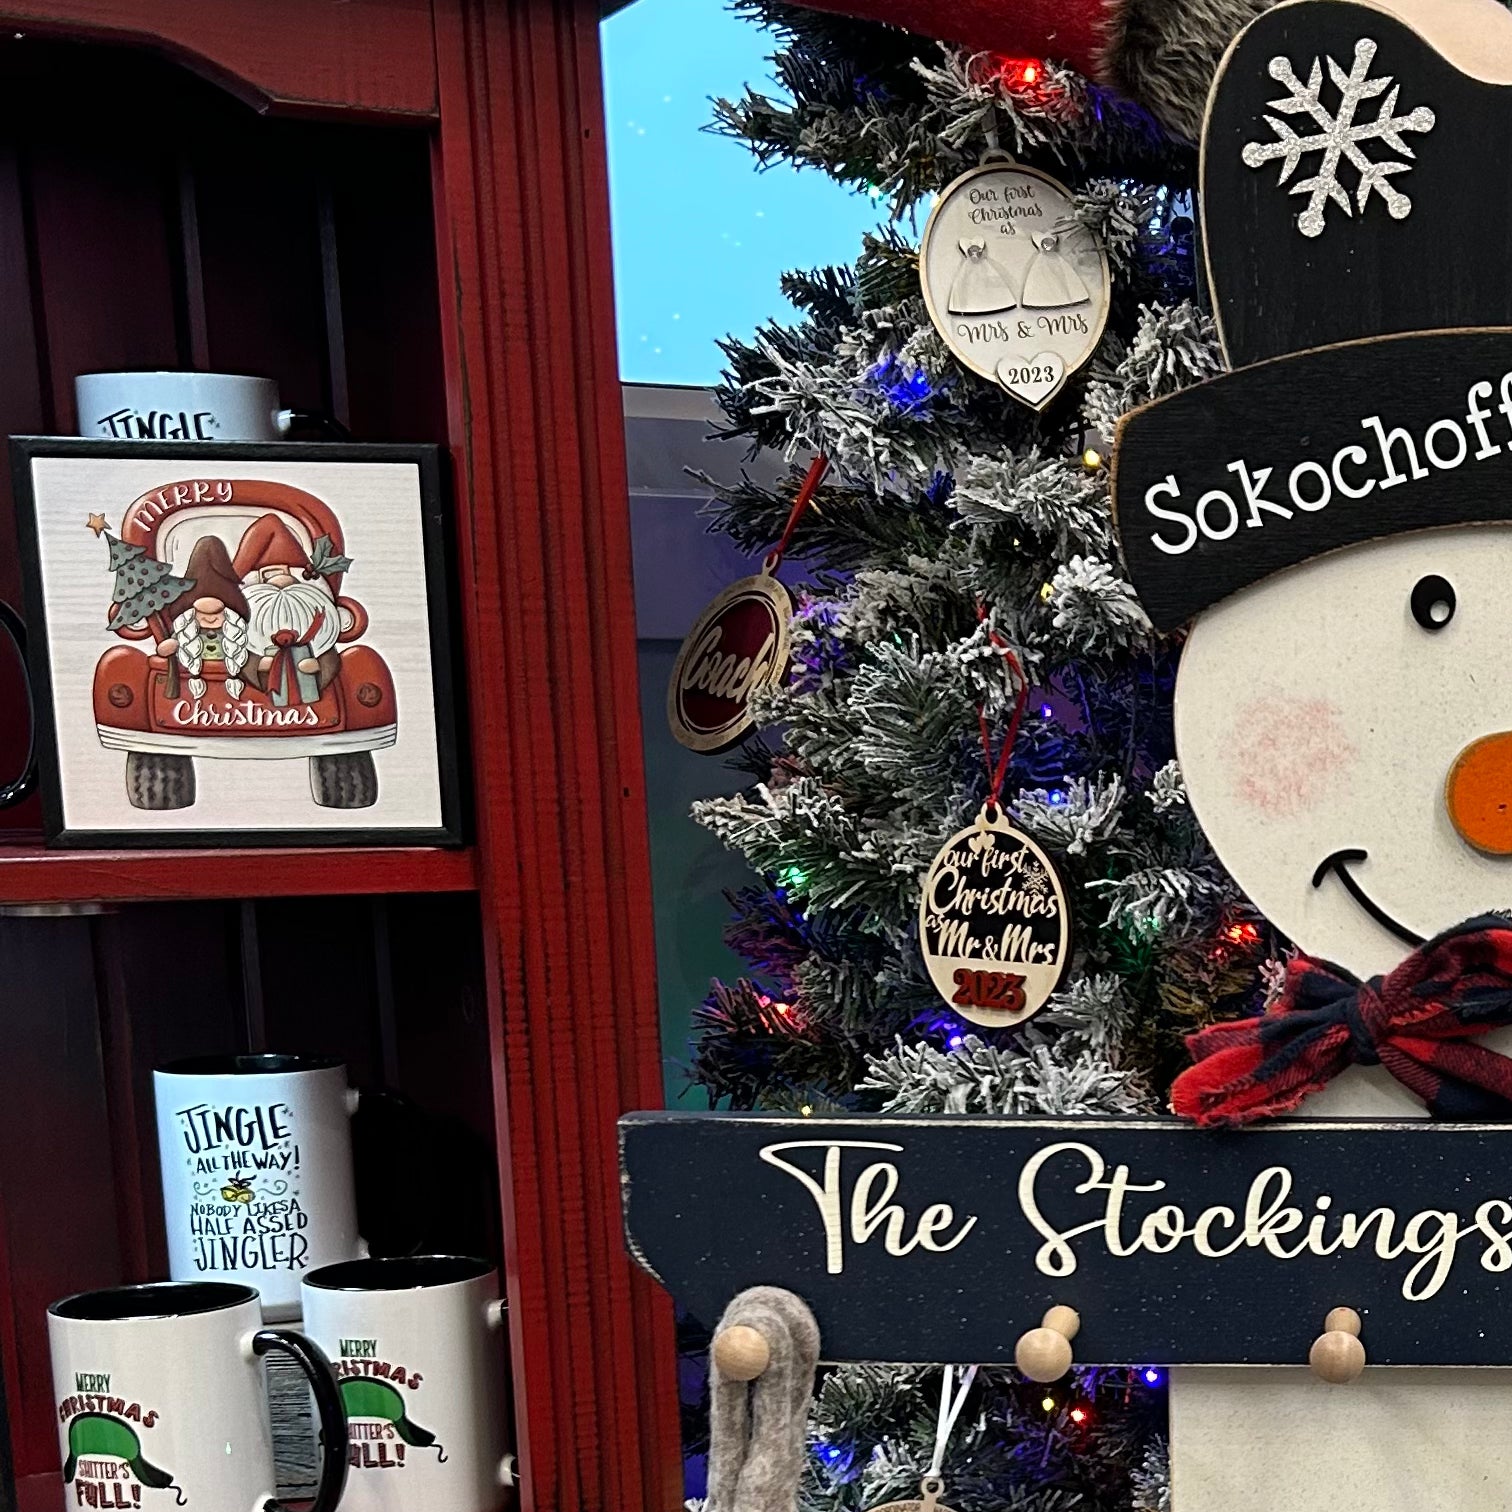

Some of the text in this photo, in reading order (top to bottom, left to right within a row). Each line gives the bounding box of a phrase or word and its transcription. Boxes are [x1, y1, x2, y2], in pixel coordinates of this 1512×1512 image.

[969, 185, 1036, 205] Our first
[968, 203, 1043, 225] Christmas
[1000, 221, 1016, 235] as
[957, 314, 1089, 344] Mrs & Mrs
[1008, 366, 1055, 385] 2023
[133, 480, 234, 533] MERRY
[173, 699, 320, 727] Christmas
[943, 843, 1029, 877] our first
[928, 865, 1059, 918] Christmas
[926, 913, 1056, 964] as Mr & Mrs
[952, 968, 1027, 1012] 2023
[176, 1104, 292, 1154] JINGLE
[196, 1145, 300, 1174] ALL THE WAY!
[190, 1198, 301, 1217] NOBODY LIKES A
[759, 1139, 977, 1274] The
[190, 1212, 308, 1235] HALF ASSED
[194, 1233, 308, 1271] JINGLER
[339, 1339, 377, 1357] MERRY
[75, 1372, 111, 1393] MERRY
[331, 1358, 424, 1390] RISTMAS
[59, 1394, 159, 1428] CHRISTMAS
[79, 1460, 130, 1479] SHITTER'S
[349, 1442, 406, 1468] ULL!
[75, 1479, 141, 1509] FULL!
